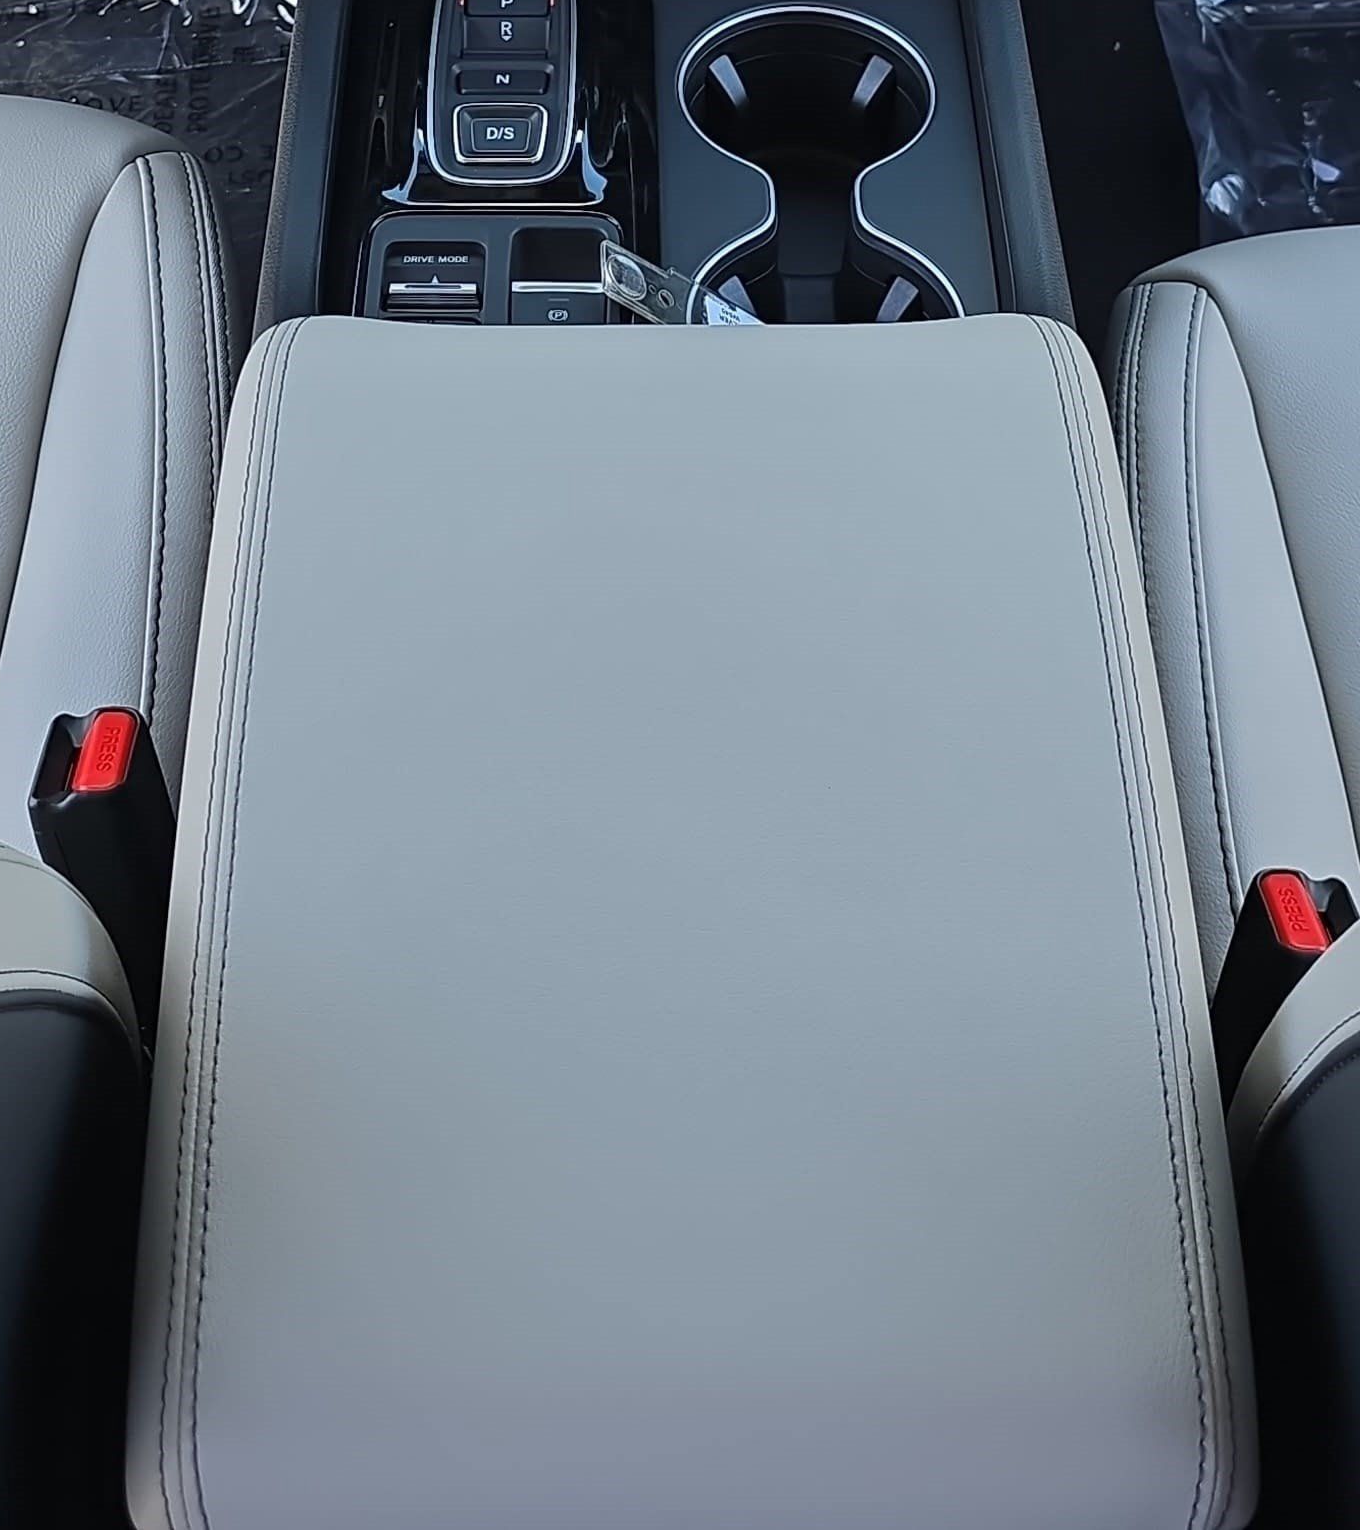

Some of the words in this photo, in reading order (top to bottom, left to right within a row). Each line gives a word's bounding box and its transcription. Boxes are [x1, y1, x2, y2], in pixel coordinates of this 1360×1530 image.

[500, 21, 512, 37] R
[496, 73, 510, 85] N
[485, 126, 515, 141] D/S
[403, 255, 434, 263] DRIVE
[438, 255, 469, 263] MODE
[96, 726, 121, 772] PRESS
[1278, 887, 1311, 932] PRESS
